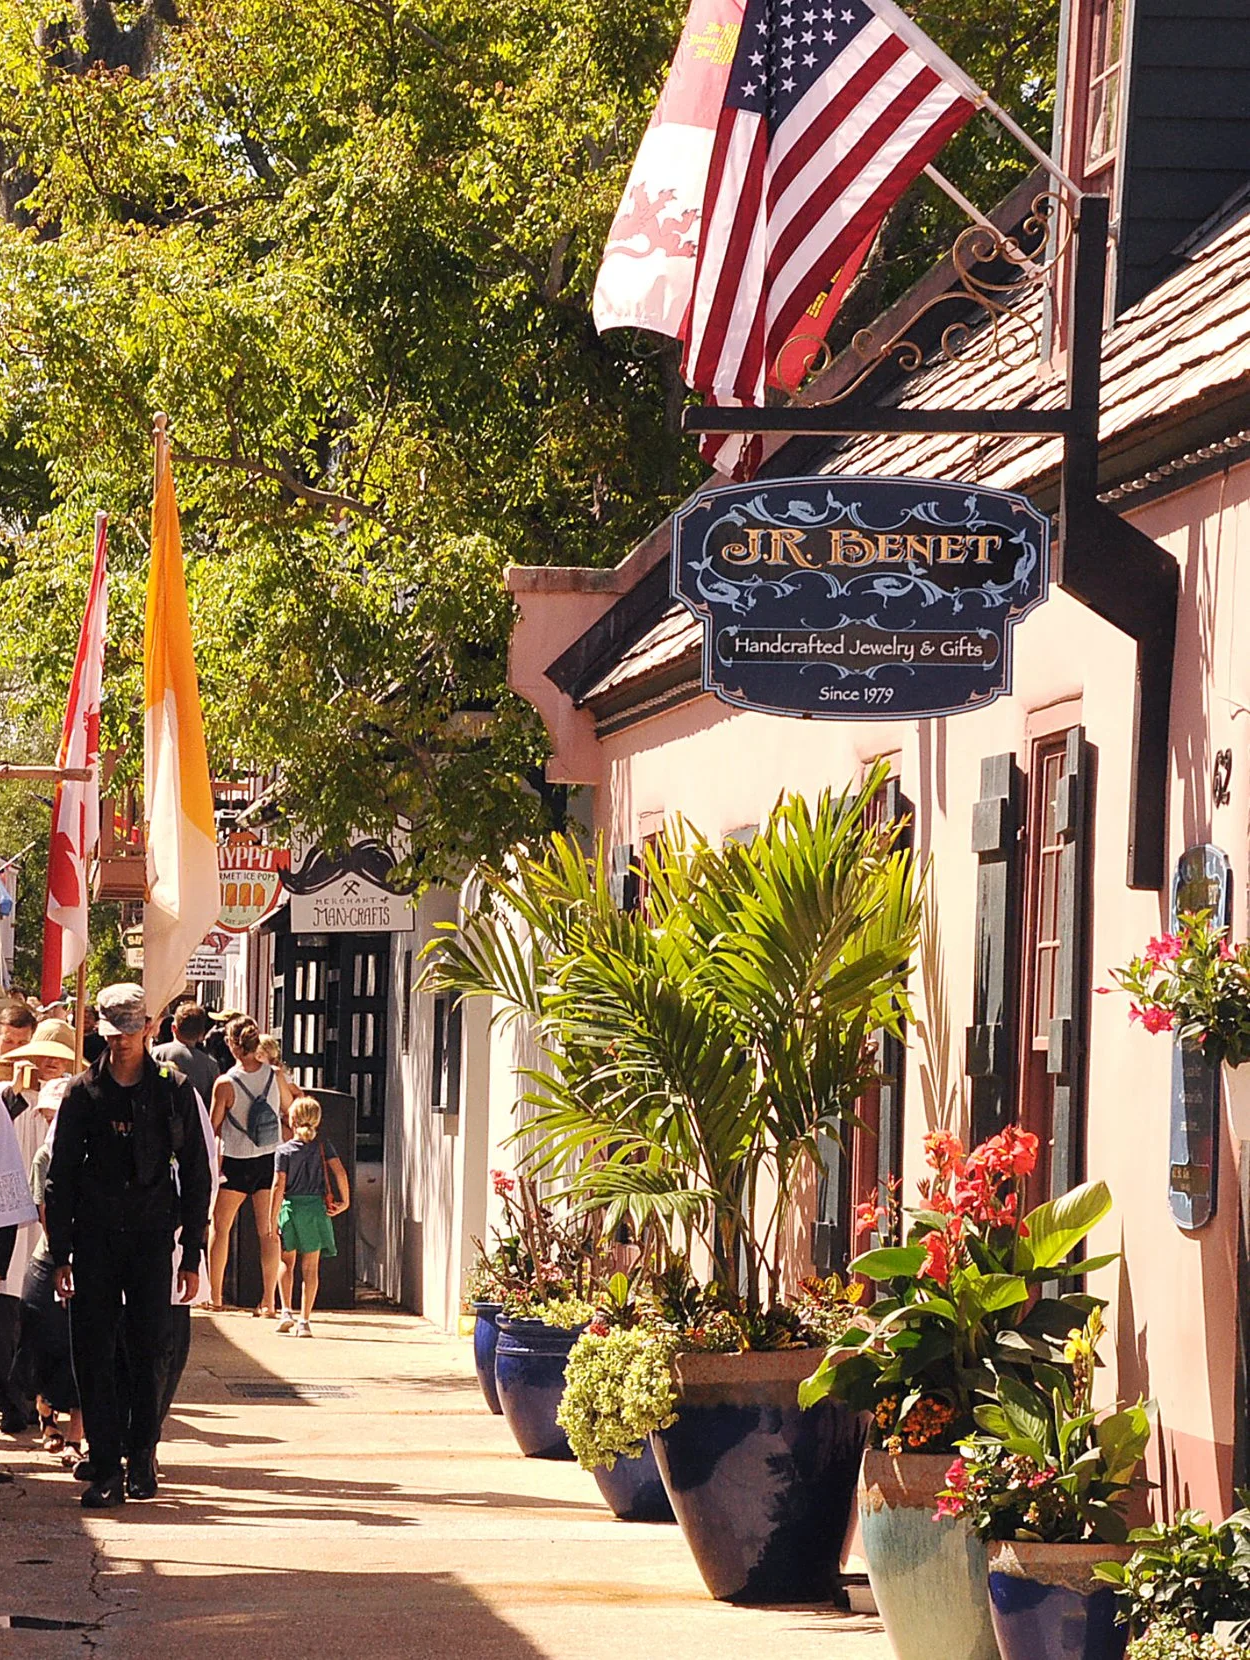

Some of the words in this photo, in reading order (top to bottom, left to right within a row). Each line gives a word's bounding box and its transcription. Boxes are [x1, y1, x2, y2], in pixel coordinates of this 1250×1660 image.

[827, 528, 1002, 567] BENET
[734, 635, 845, 656] Handcrafted
[849, 638, 915, 662] Jewelry
[920, 641, 935, 656] &
[940, 637, 984, 657] Gifts
[819, 685, 860, 701] Since
[863, 687, 894, 704] 1979
[219, 872, 241, 881] RMET
[244, 872, 255, 880] ICE
[257, 873, 276, 882] POPS
[312, 906, 390, 927] MAN-CRAFTS
